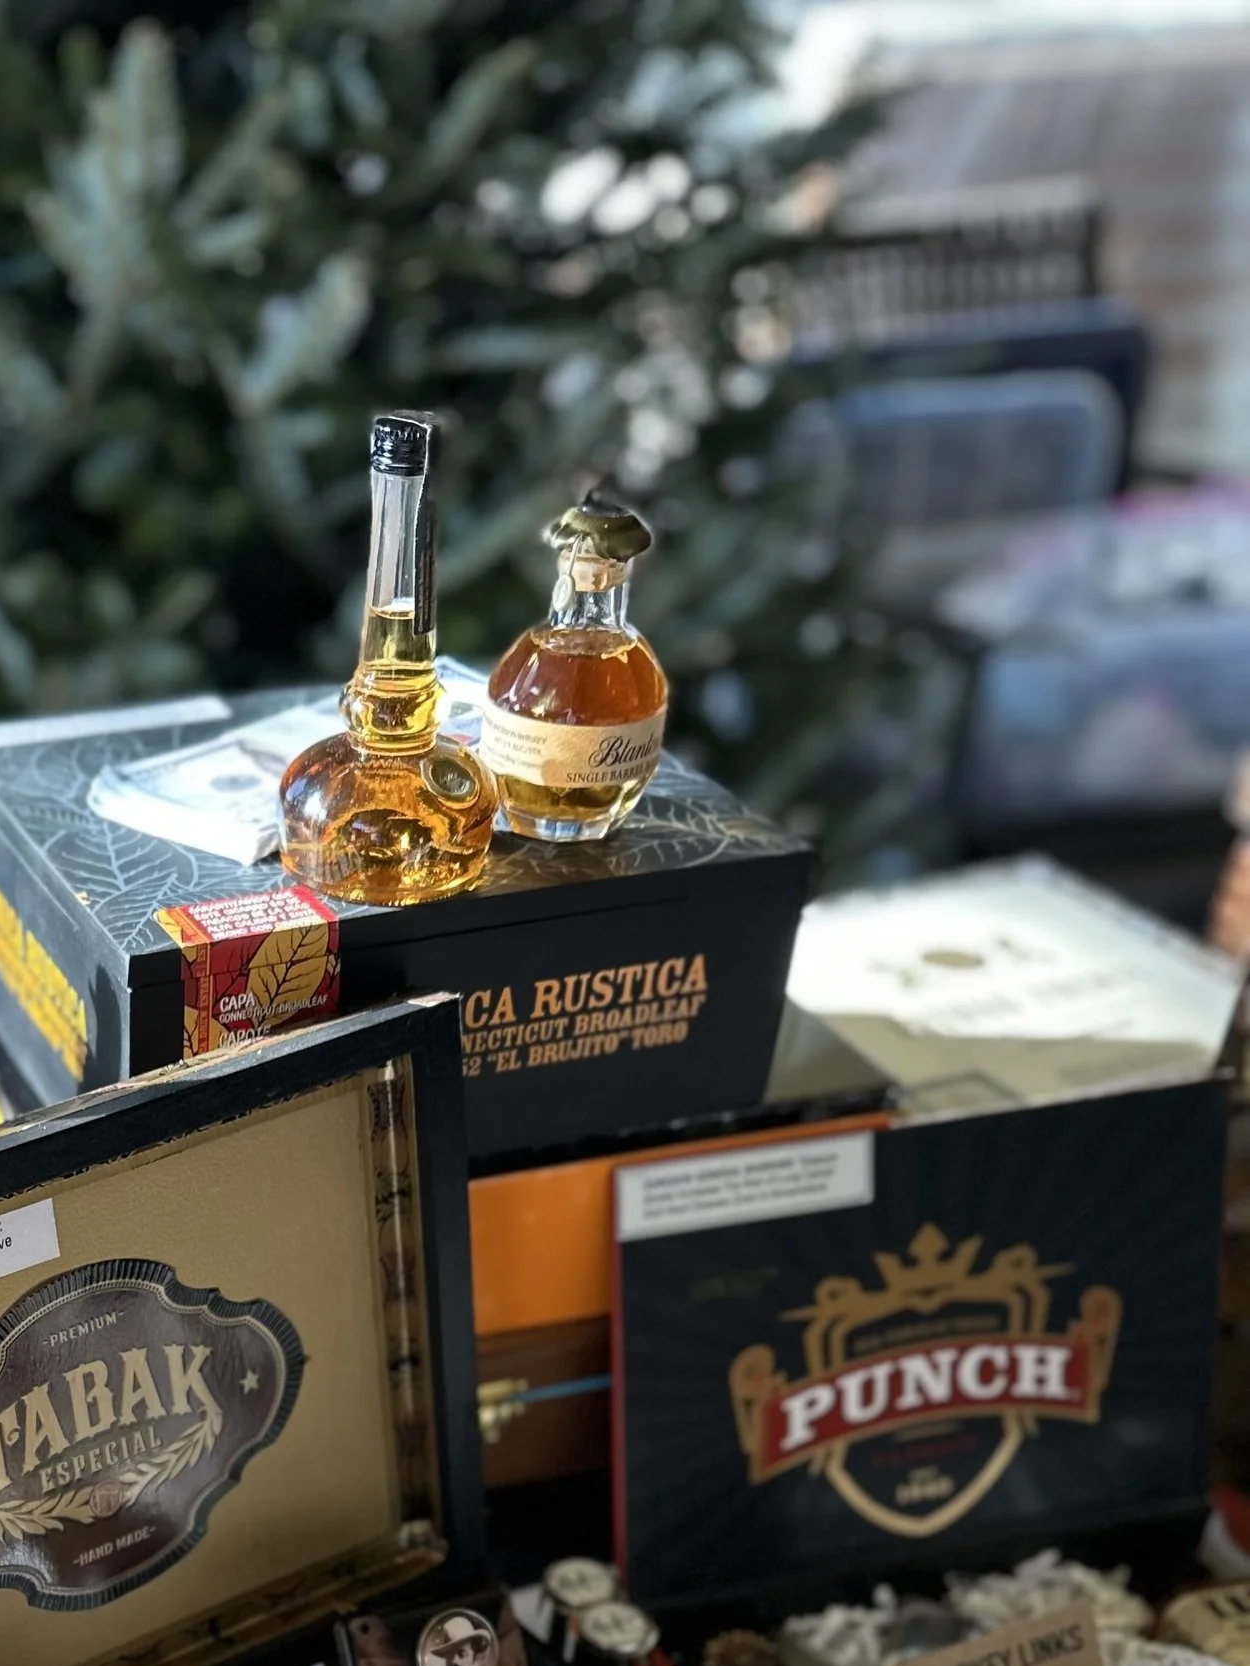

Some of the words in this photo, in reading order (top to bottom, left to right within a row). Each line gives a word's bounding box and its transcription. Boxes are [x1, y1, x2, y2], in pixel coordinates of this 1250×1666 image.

[566, 770, 607, 784] SINGLE
[219, 991, 256, 1014] CAPA
[464, 986, 517, 1029] CA
[530, 953, 708, 1019] RUSTICA
[573, 994, 707, 1037] BROADLEAF
[631, 1020, 689, 1050] TORO
[778, 1343, 1073, 1451] PUNCH
[40, 1425, 163, 1493] ESPECIAL
